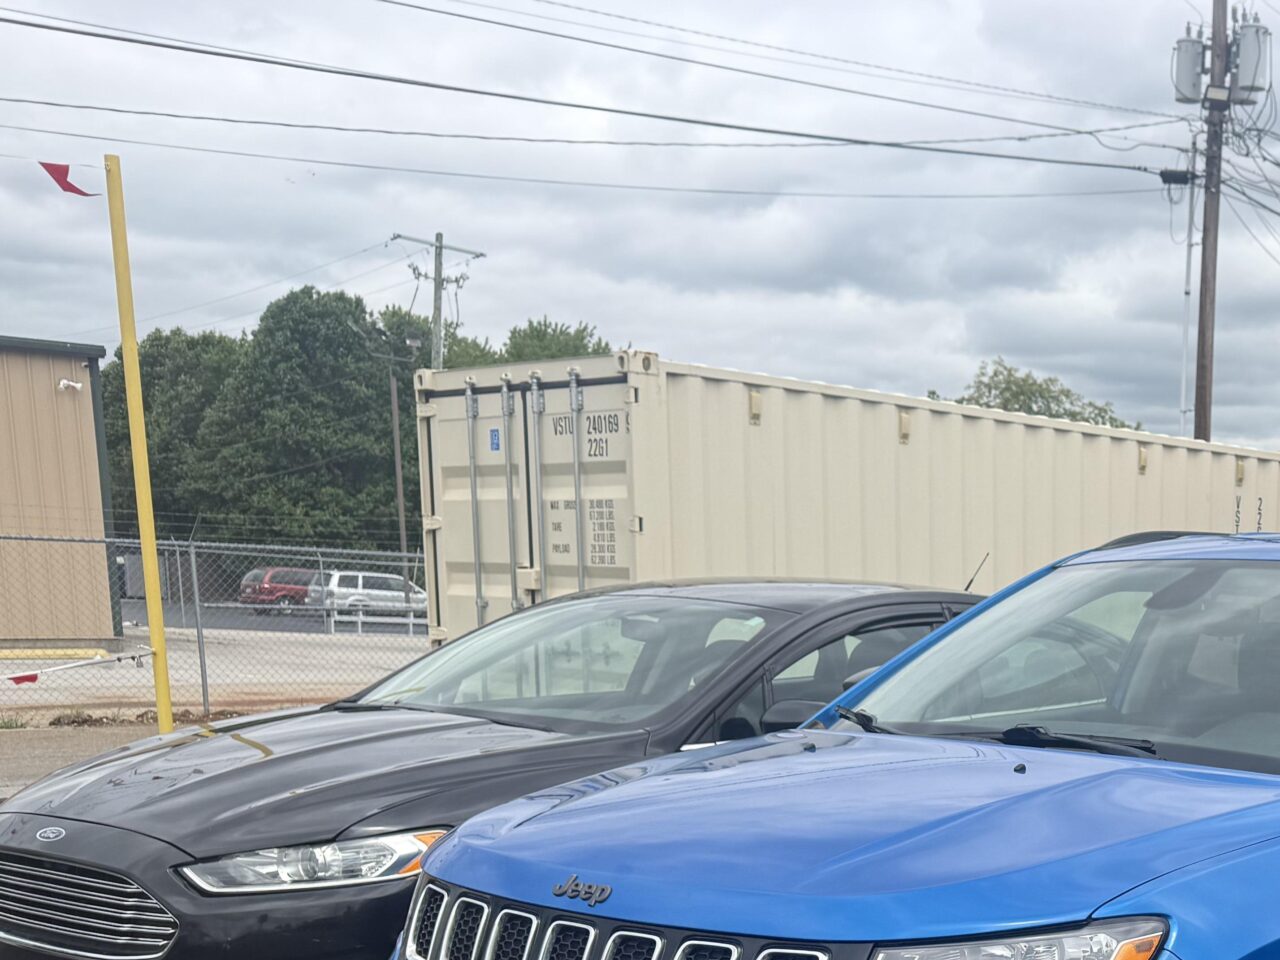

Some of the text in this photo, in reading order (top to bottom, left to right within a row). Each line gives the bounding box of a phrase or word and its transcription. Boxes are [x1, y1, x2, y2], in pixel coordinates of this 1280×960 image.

[552, 416, 574, 436] VSTU
[586, 414, 619, 435] 240169
[588, 438, 608, 457] 22G1
[553, 874, 613, 908] Jeep
